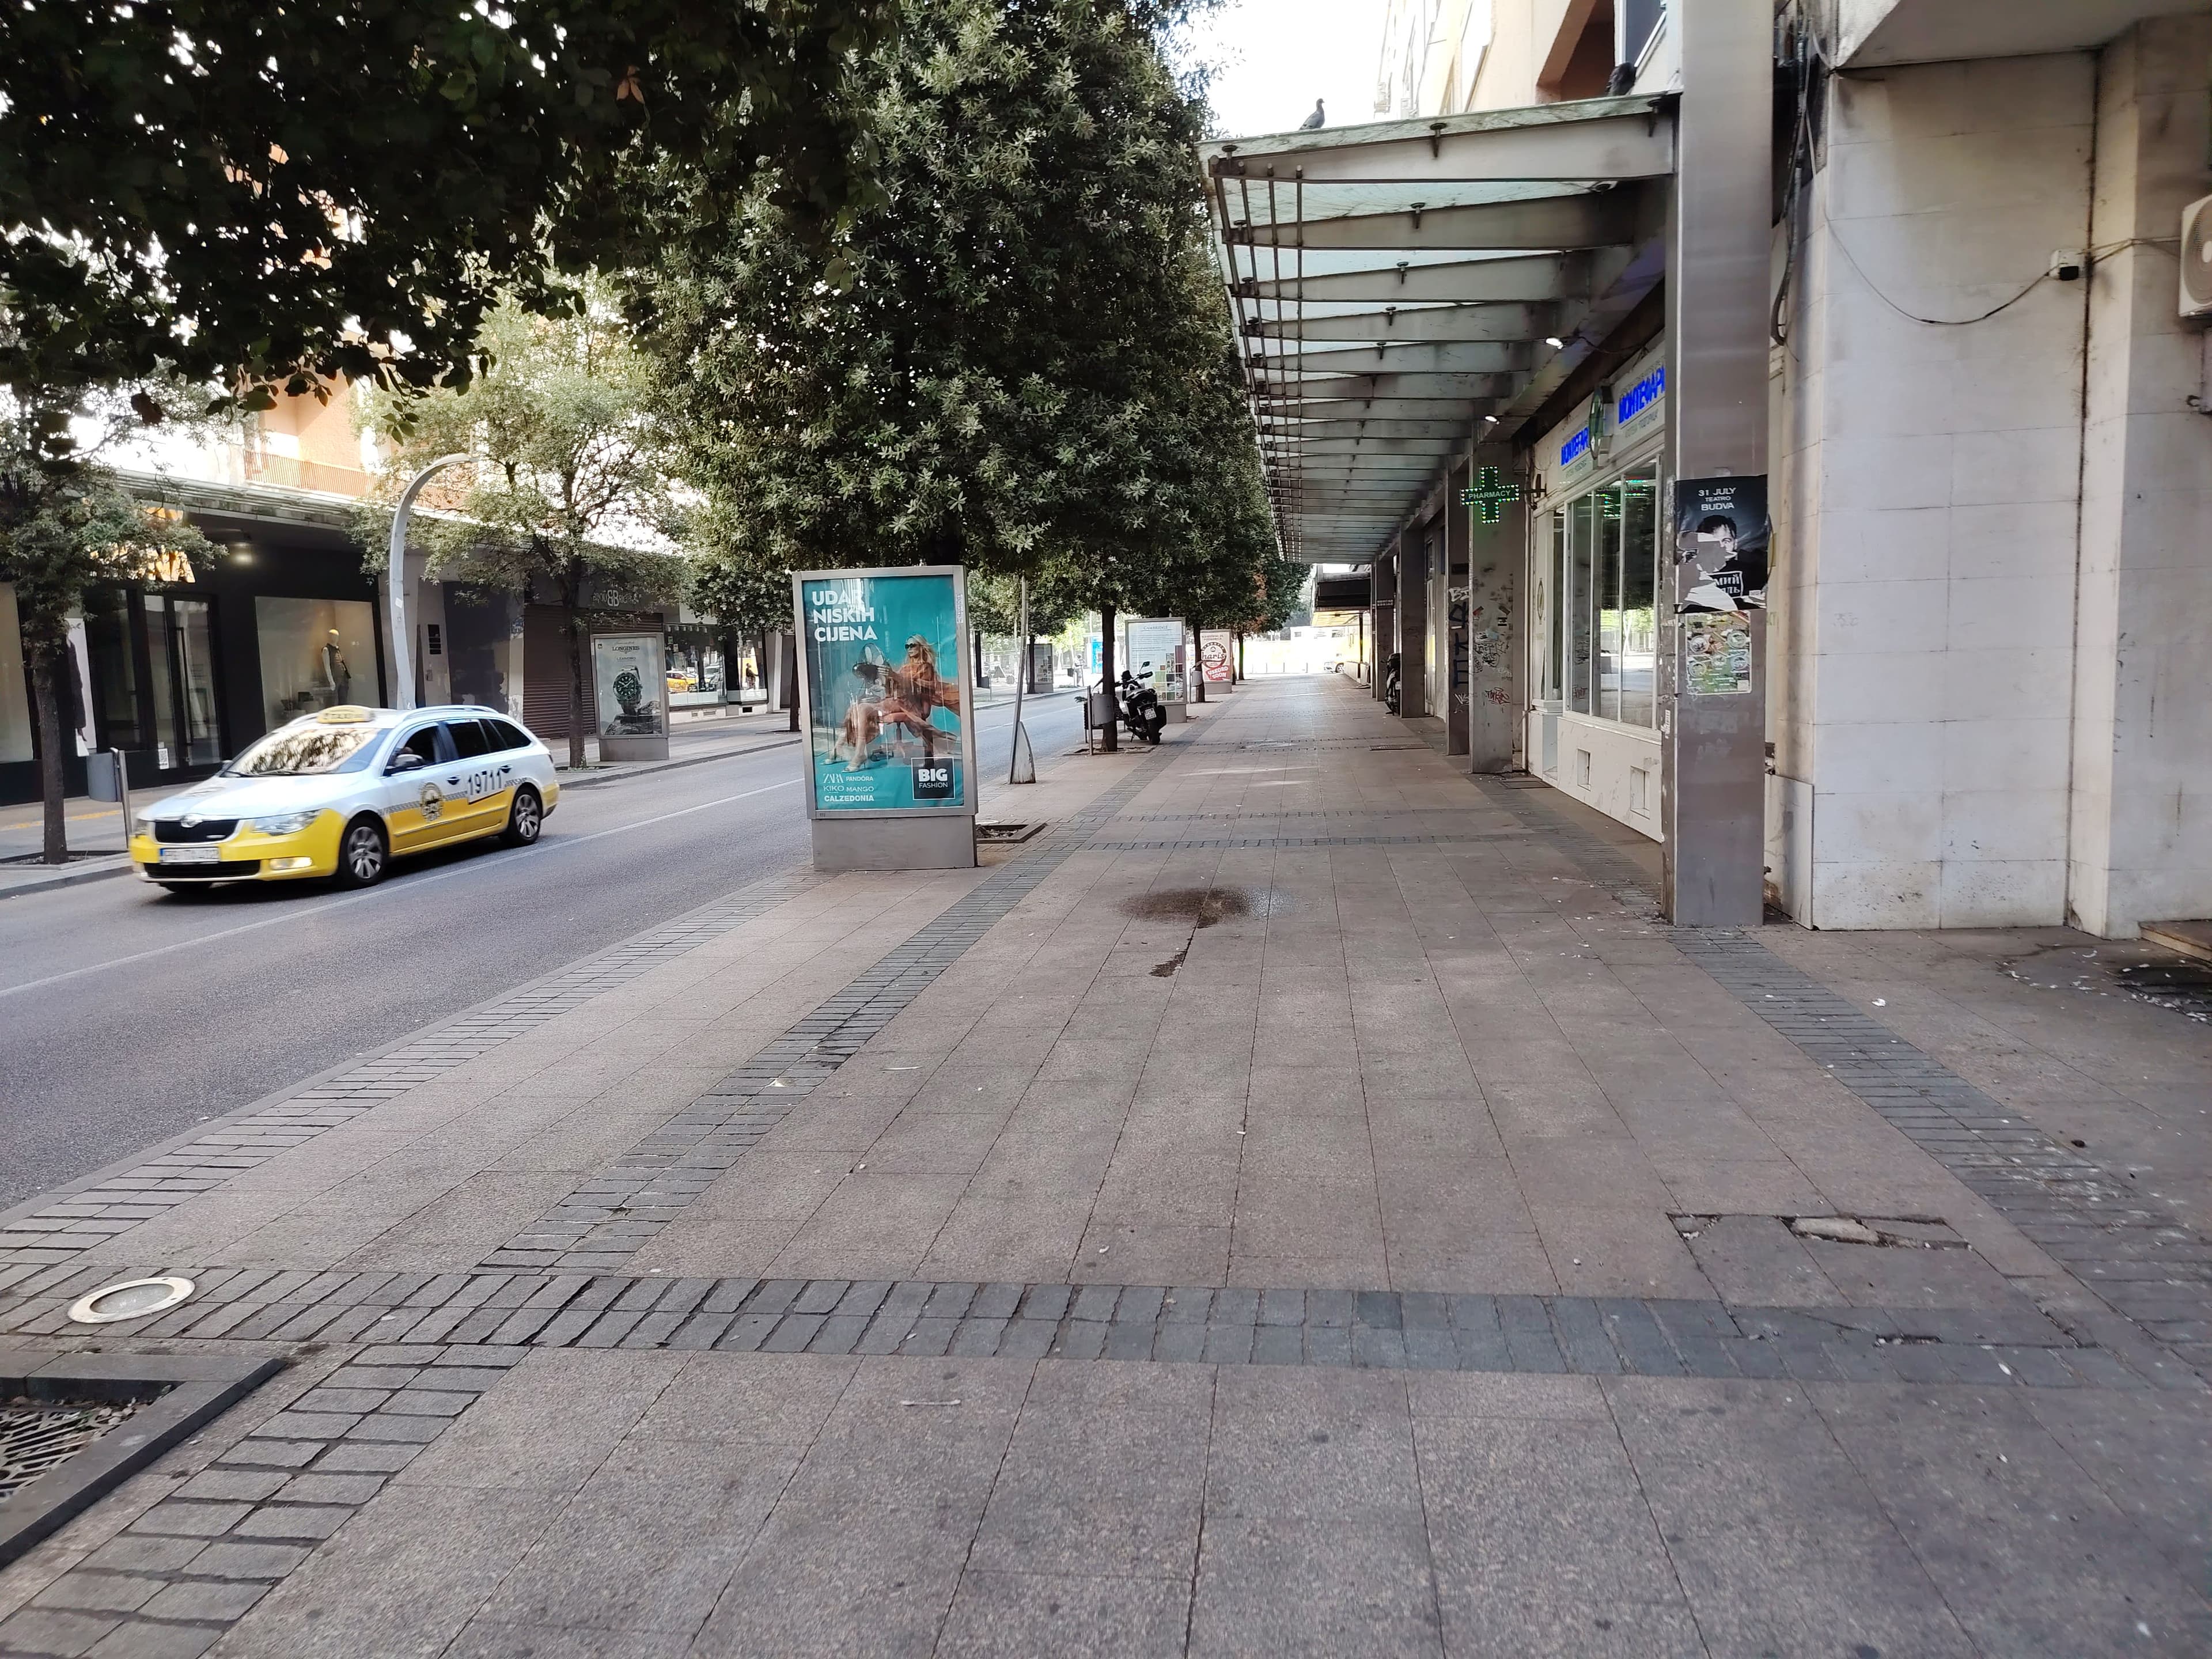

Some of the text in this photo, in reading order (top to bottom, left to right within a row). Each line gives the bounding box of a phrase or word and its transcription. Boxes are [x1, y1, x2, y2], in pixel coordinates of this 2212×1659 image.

[1468, 490, 1510, 499] PHARMACY
[1713, 487, 1737, 495] JULY
[1700, 502, 1735, 511] BUDVA
[812, 589, 865, 605] UDAR
[813, 607, 874, 624] NISKIH
[814, 625, 878, 642] CIJENA
[823, 774, 844, 783] ZARA
[918, 768, 948, 782] BIG
[467, 769, 502, 796] 19711
